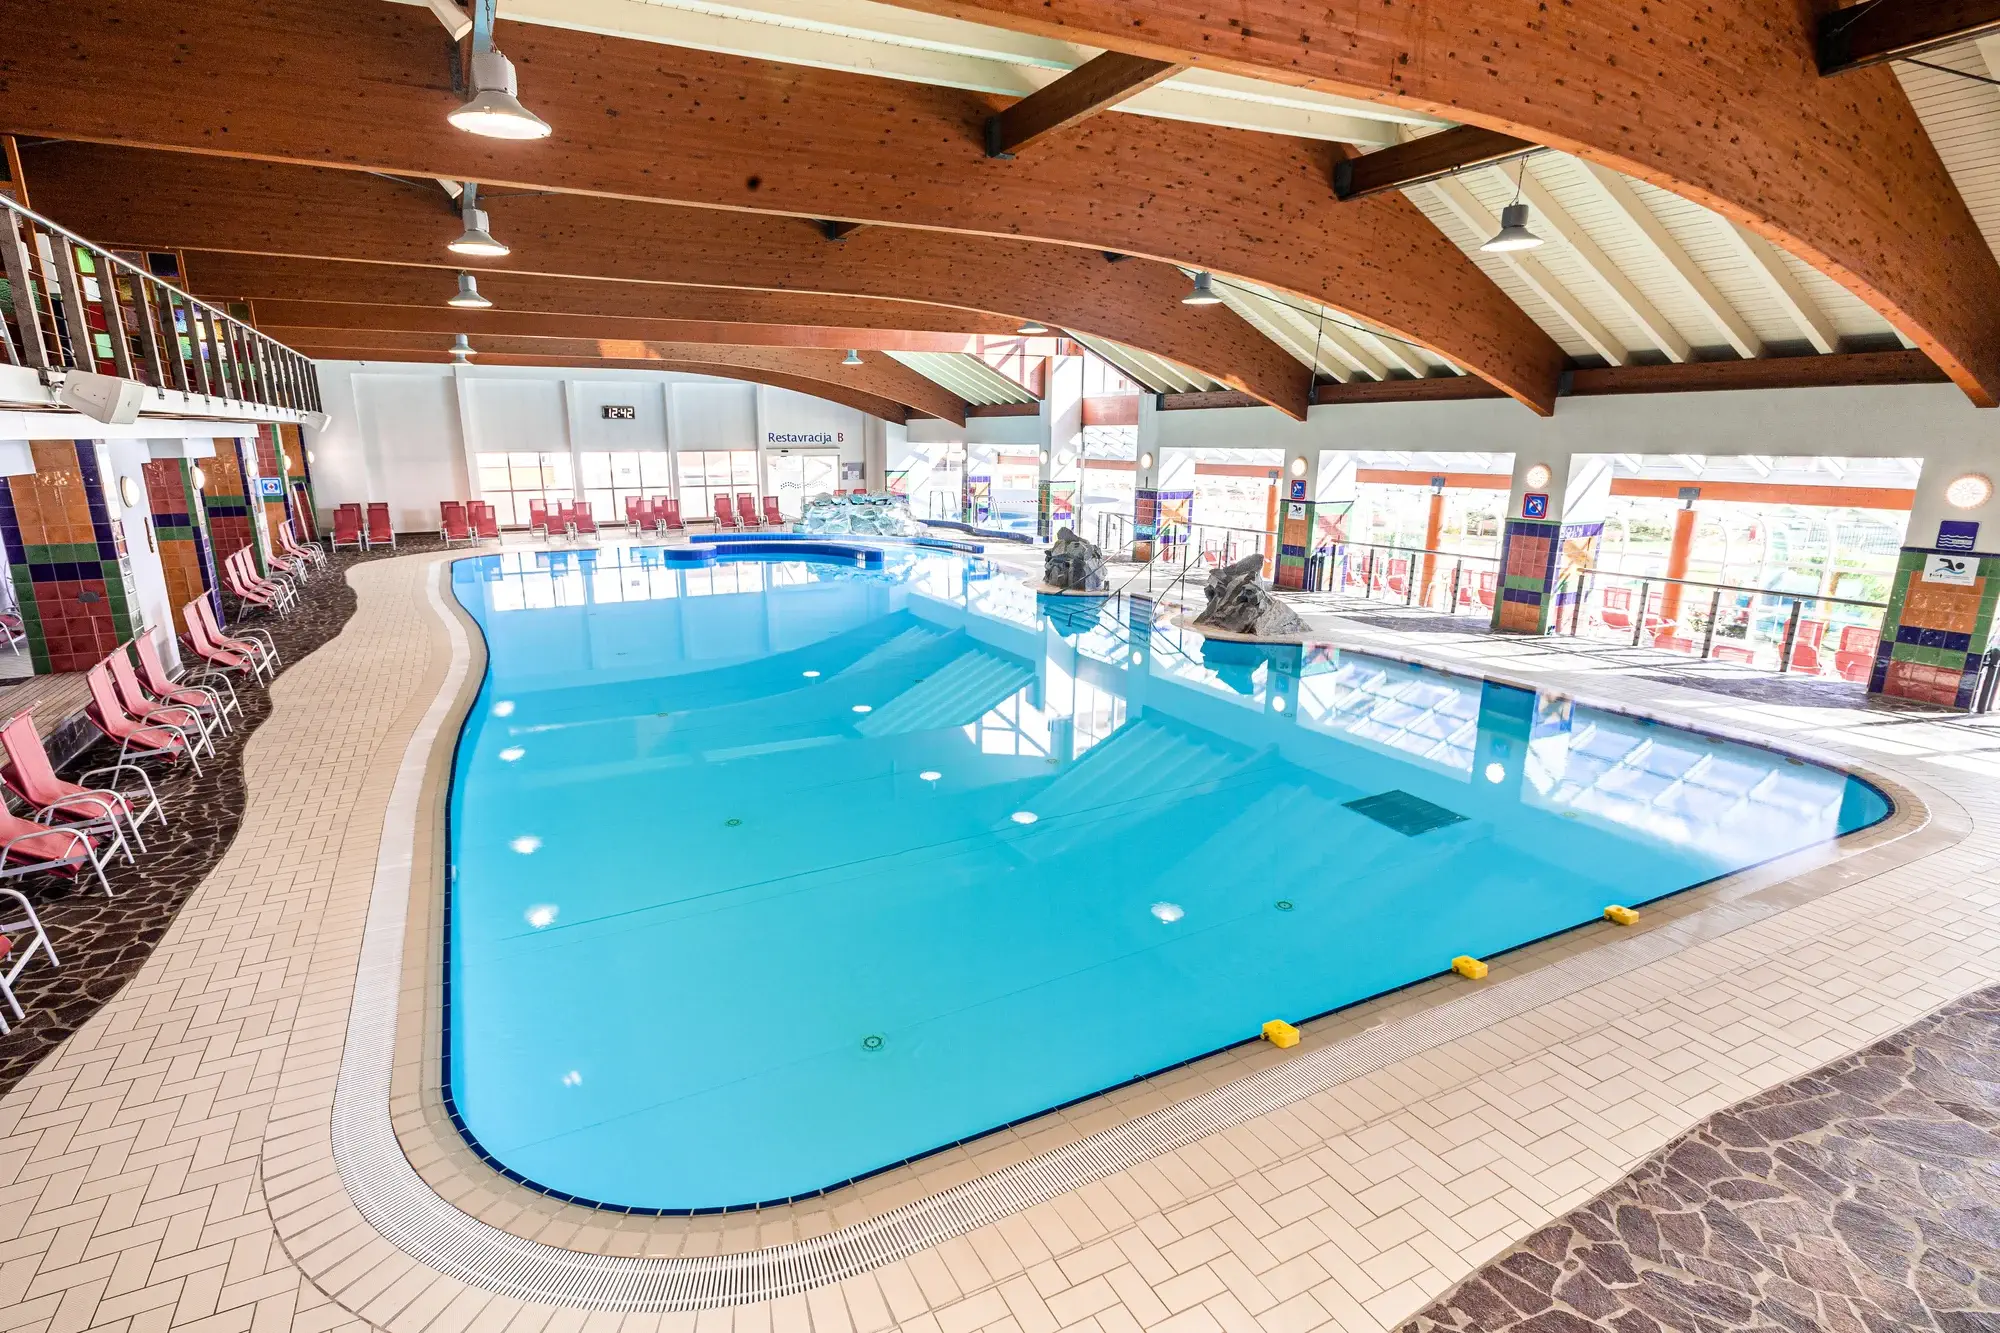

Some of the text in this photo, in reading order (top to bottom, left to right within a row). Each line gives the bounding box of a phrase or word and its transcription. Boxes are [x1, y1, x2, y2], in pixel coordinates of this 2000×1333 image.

[608, 407, 633, 419] 12:42
[768, 432, 844, 444] Restavracija B
